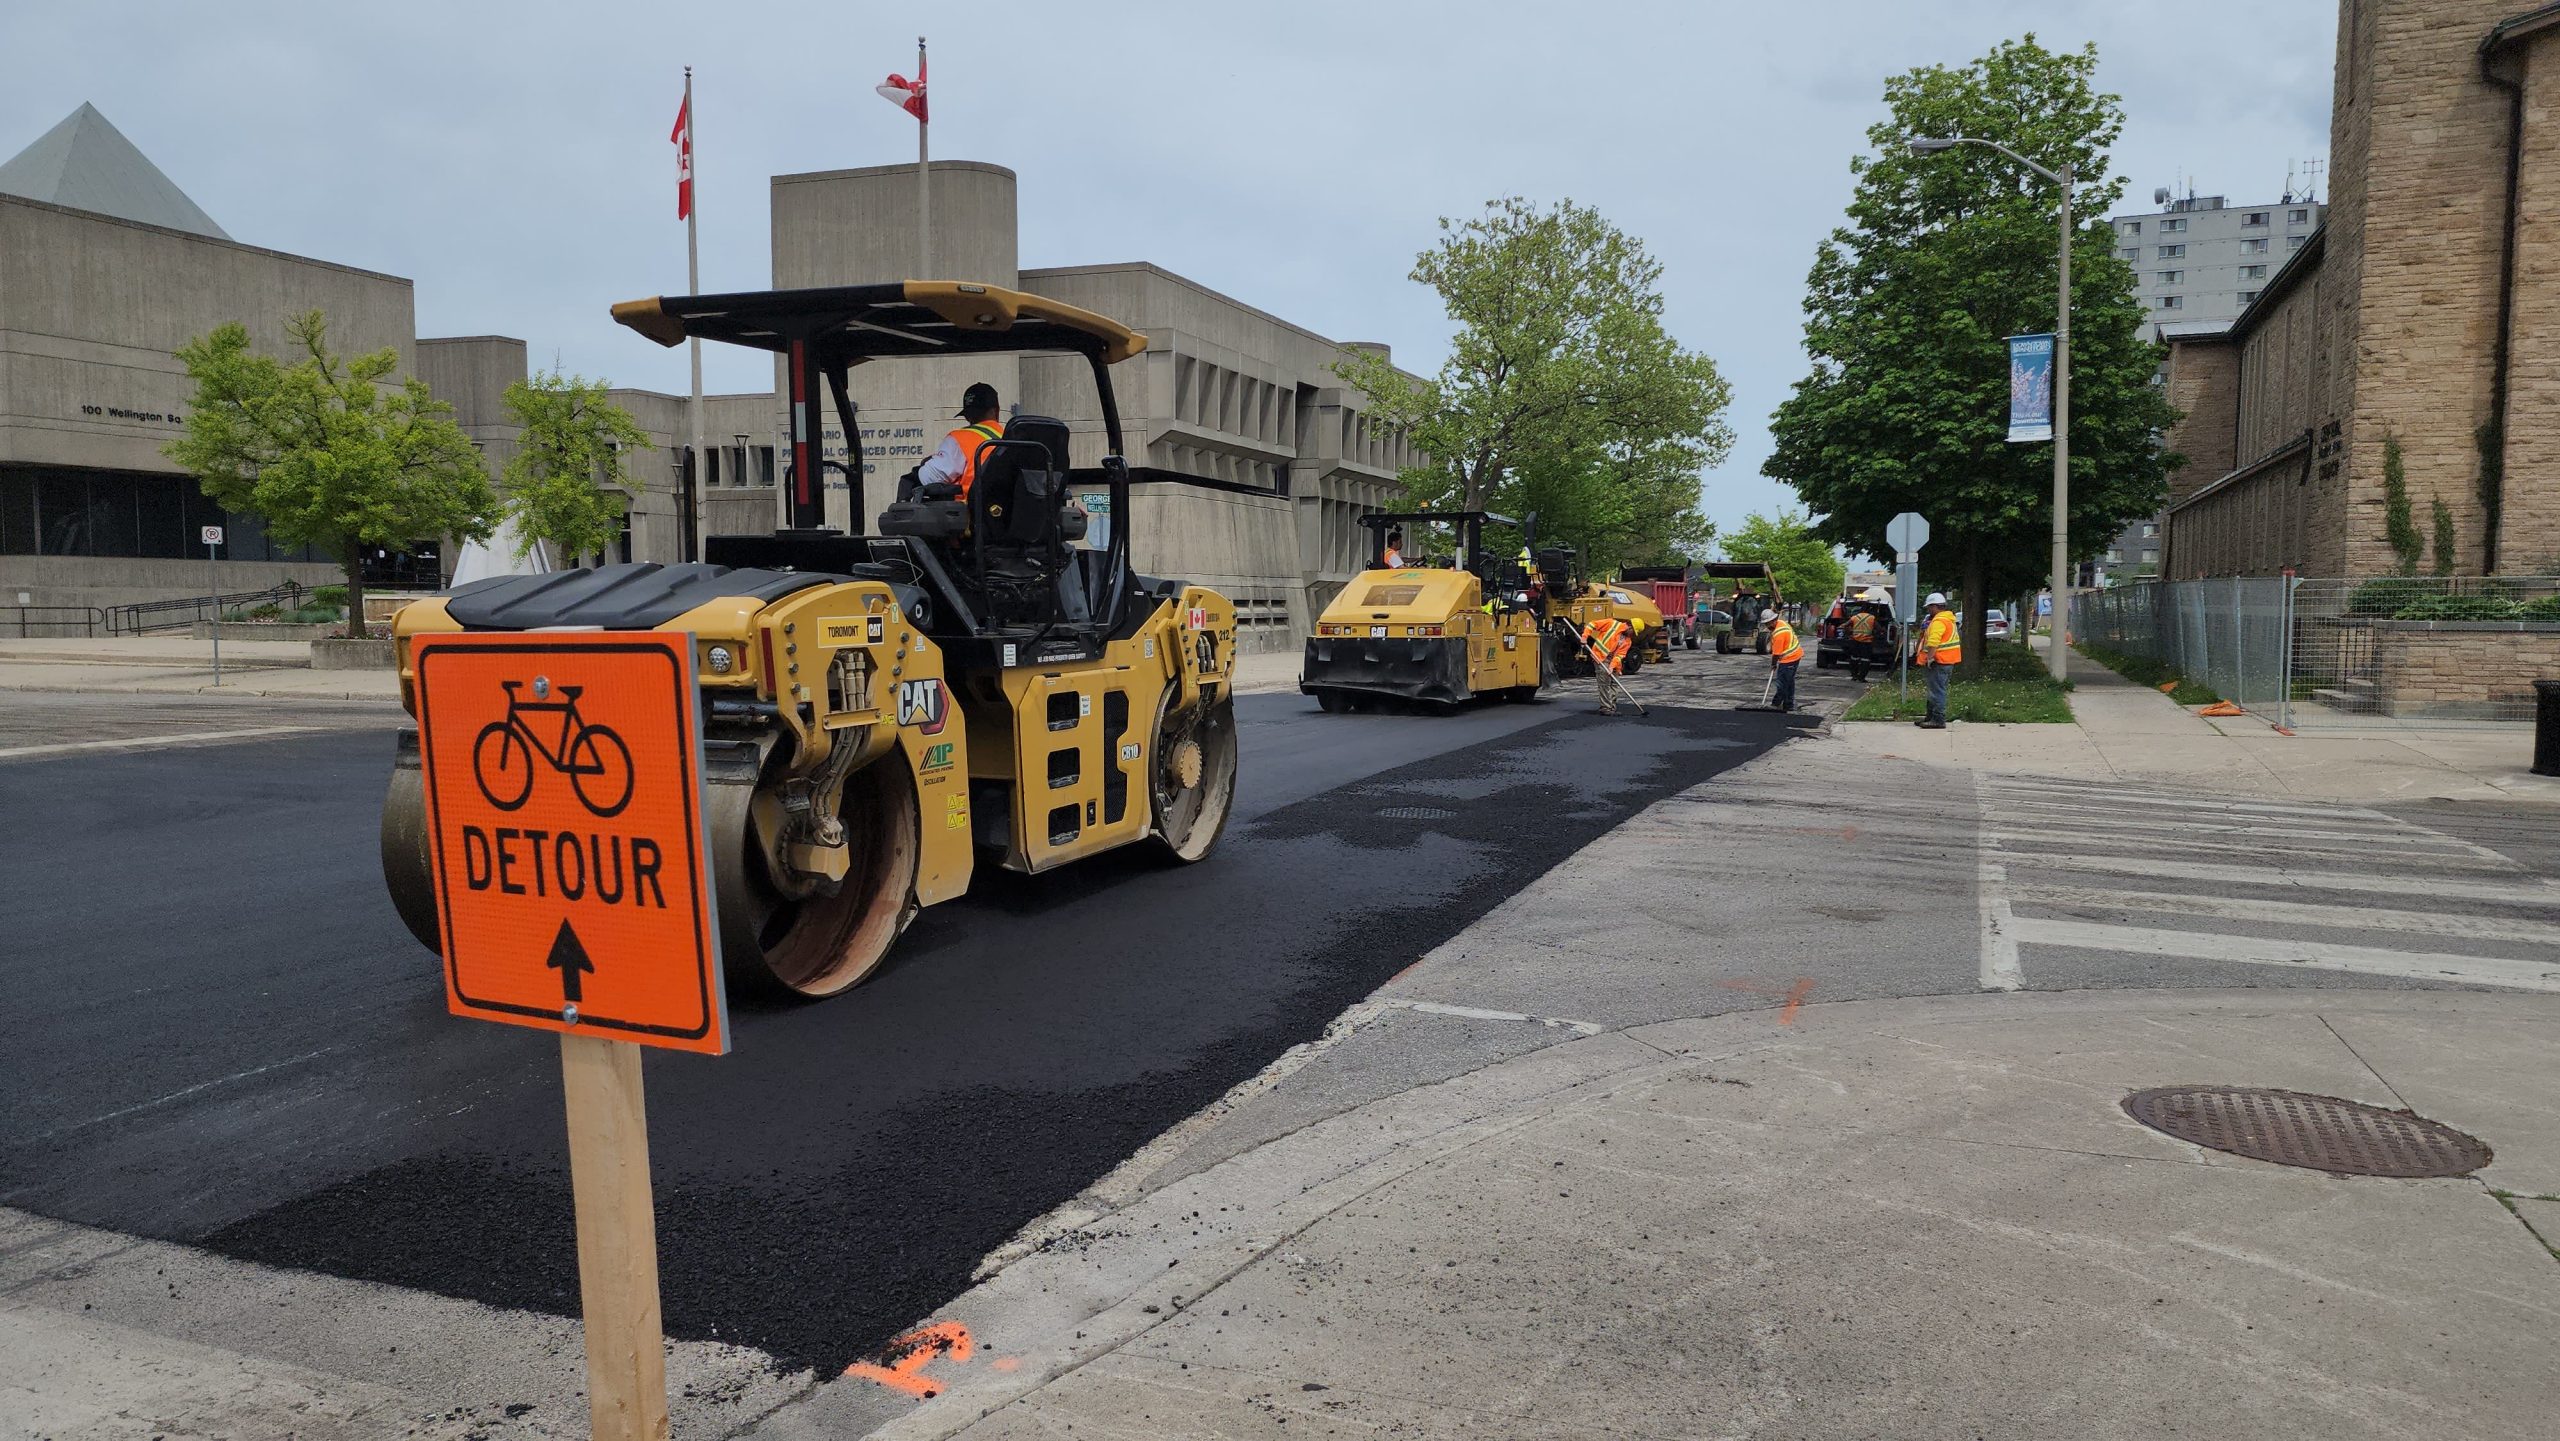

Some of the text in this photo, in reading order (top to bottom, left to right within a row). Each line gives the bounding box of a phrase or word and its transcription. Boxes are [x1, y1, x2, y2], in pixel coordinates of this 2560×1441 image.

[81, 404, 184, 424] 100 Wellington Sq.
[878, 428, 891, 438] OF
[828, 624, 882, 639] TOROMONT CAT
[1219, 629, 1230, 641] 212
[1371, 627, 1387, 637] CAT
[897, 680, 938, 725] CAT
[1121, 744, 1139, 761] CB10
[463, 825, 667, 908] DETOUR
